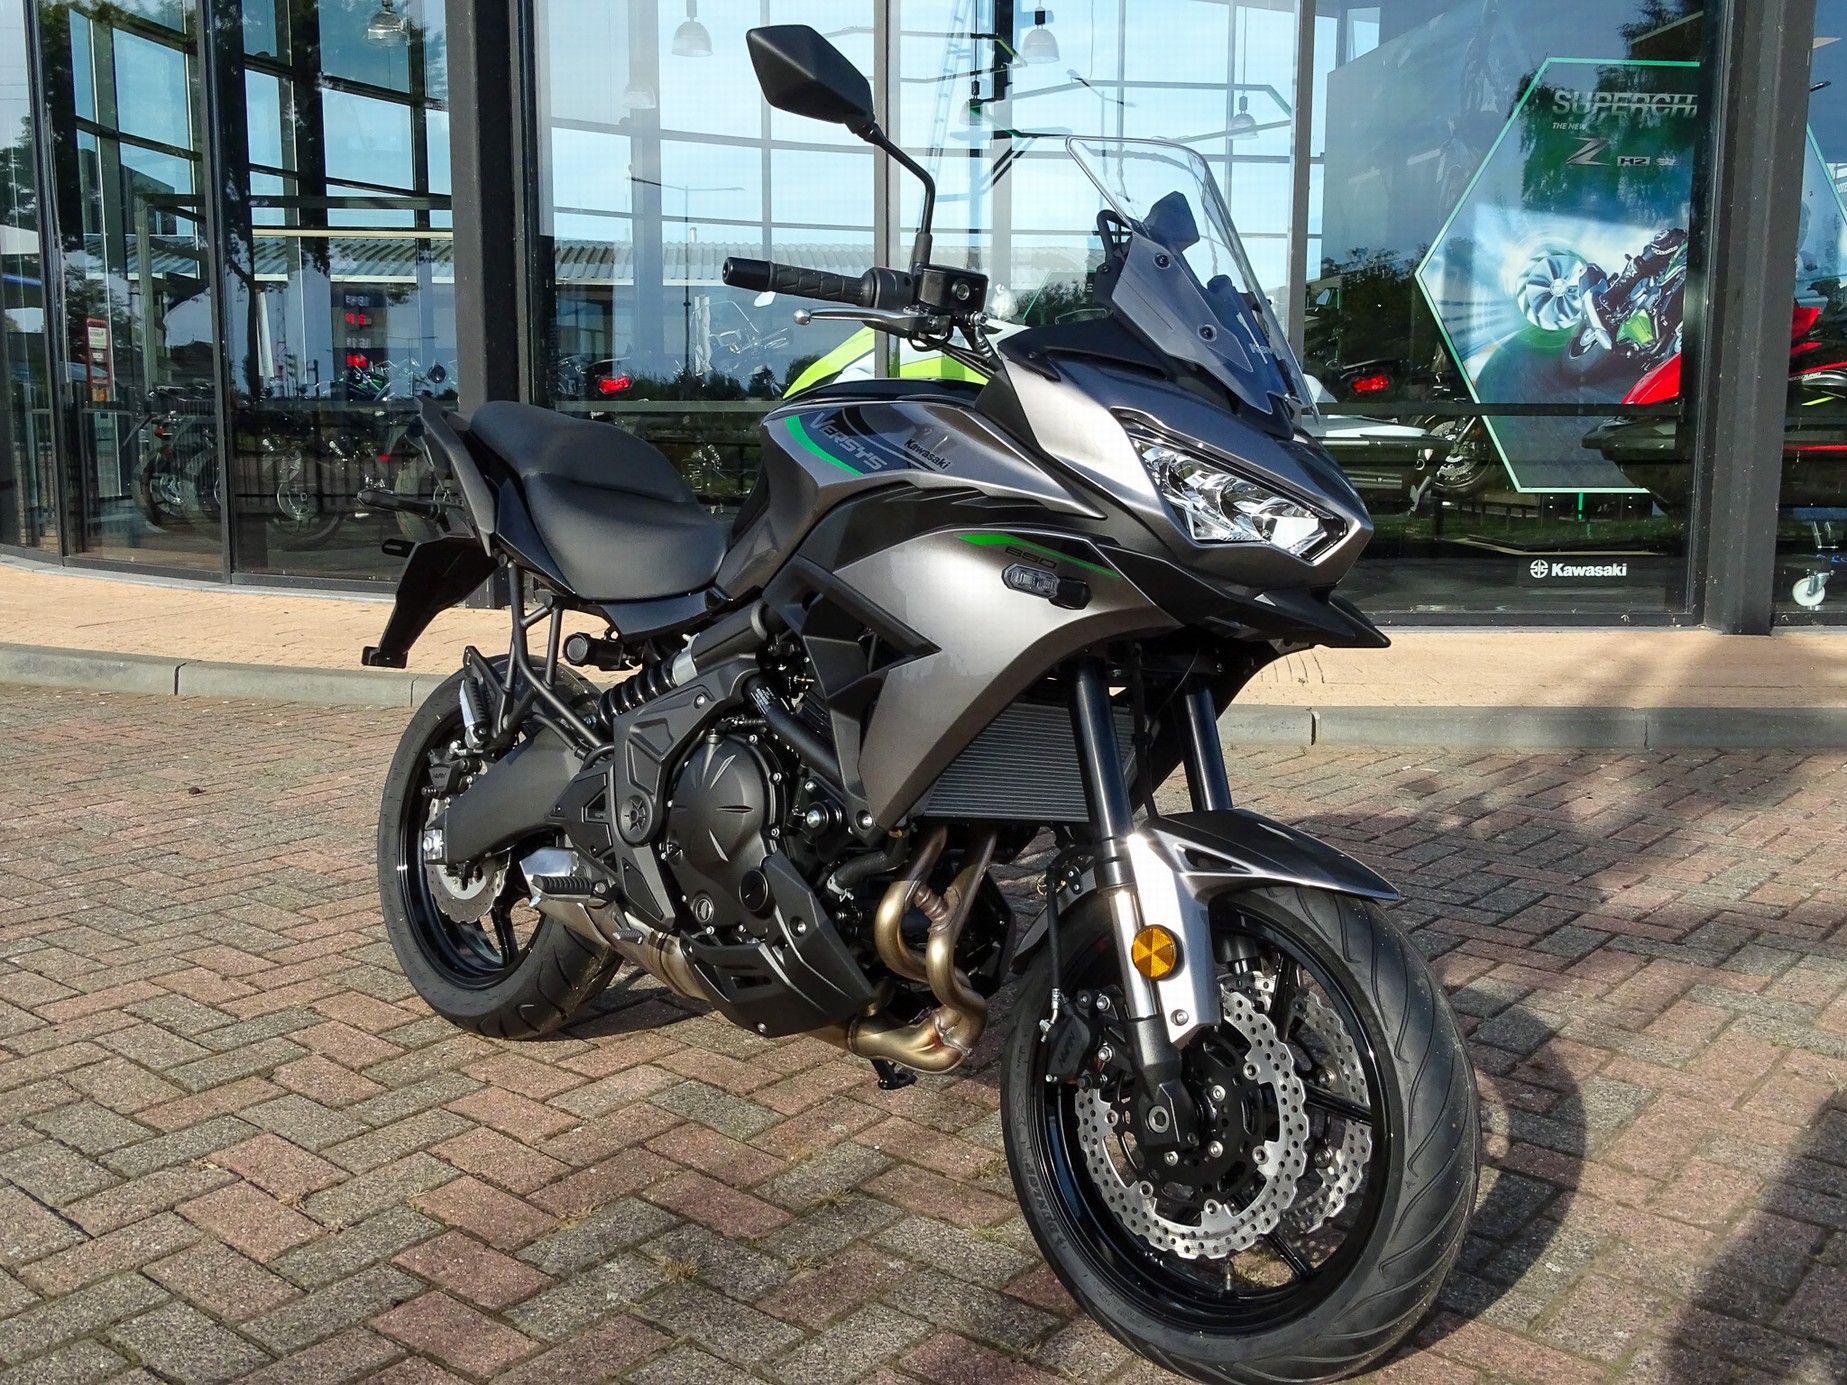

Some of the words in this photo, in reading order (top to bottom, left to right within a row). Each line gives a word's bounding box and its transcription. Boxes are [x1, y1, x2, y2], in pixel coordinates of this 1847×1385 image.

[1552, 122, 1567, 130] THE
[1619, 157, 1648, 165] H2
[809, 412, 888, 471] VERSYS
[903, 438, 952, 470] Kawasaki
[1551, 563, 1628, 577] Kawasaki
